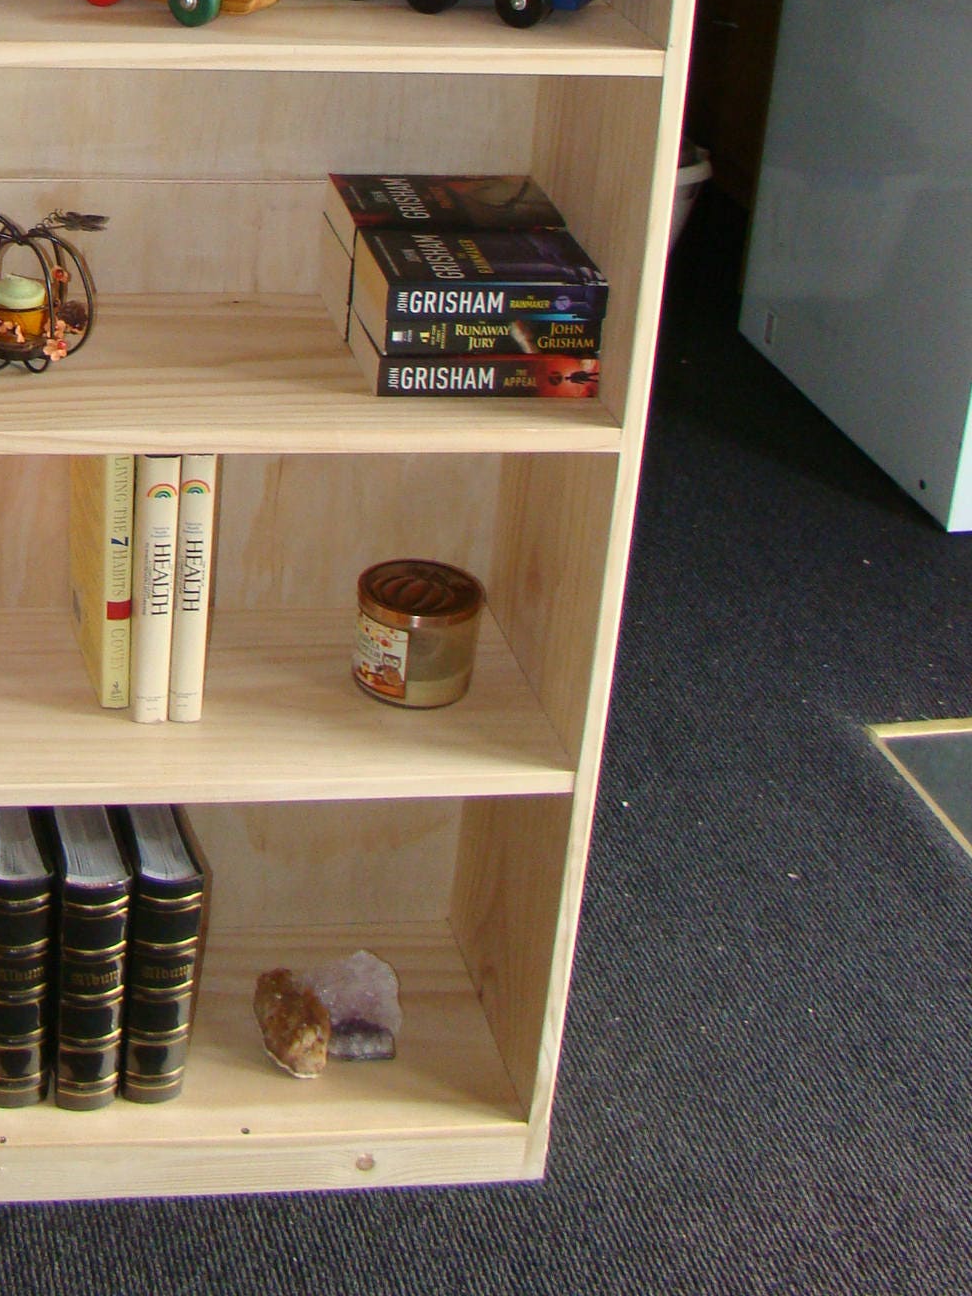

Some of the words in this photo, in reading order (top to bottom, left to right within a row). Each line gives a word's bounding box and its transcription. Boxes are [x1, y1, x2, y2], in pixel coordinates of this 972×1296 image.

[380, 178, 431, 220] GRISHAM
[412, 234, 465, 280] GRISHAM
[397, 291, 409, 313] JOHN
[410, 291, 505, 314] GRISHAM
[455, 323, 510, 337] RUNAWAY
[550, 322, 584, 336] JOHN
[468, 334, 496, 350] JURY
[537, 336, 595, 349] GRISHAM
[387, 367, 399, 389] JOHN
[400, 366, 494, 390] GRISHAM
[503, 376, 537, 387] APPEAL
[114, 456, 130, 503] LIVING
[113, 506, 128, 533] THE
[111, 535, 129, 550] 7
[111, 550, 127, 596] HABITS
[151, 544, 171, 615] HEALTH
[182, 540, 204, 611] HEALTH
